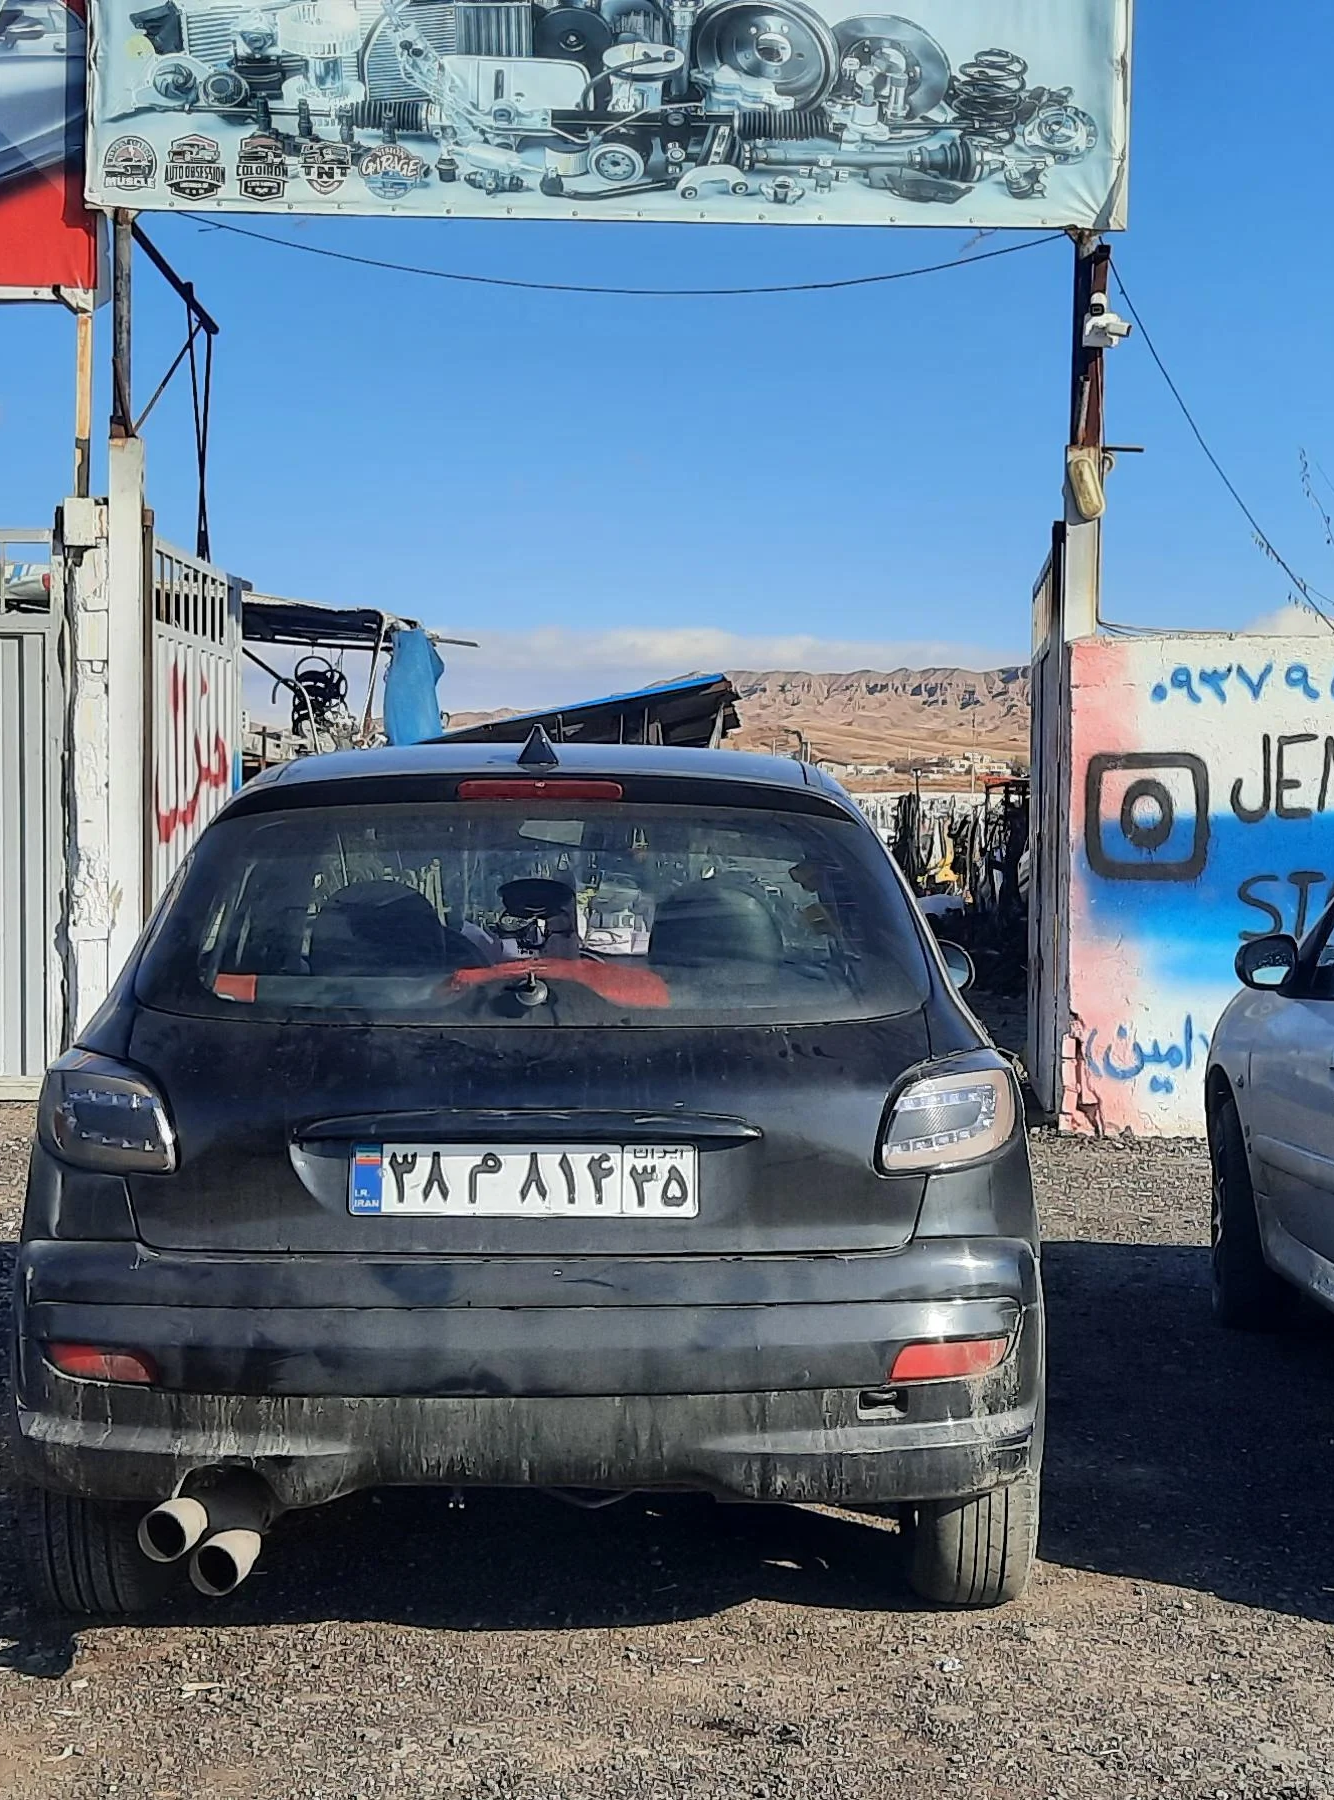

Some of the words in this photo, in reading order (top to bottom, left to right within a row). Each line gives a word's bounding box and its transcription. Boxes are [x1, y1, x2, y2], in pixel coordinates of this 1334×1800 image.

[164, 164, 184, 183] AUTO
[185, 164, 226, 185] OBSESSION
[300, 164, 351, 180] TNT
[361, 154, 422, 177] GARAGE
[105, 176, 155, 188] MUSCLE
[629, 1163, 688, 1208] ۳۵
[354, 1200, 379, 1208] IRAN
